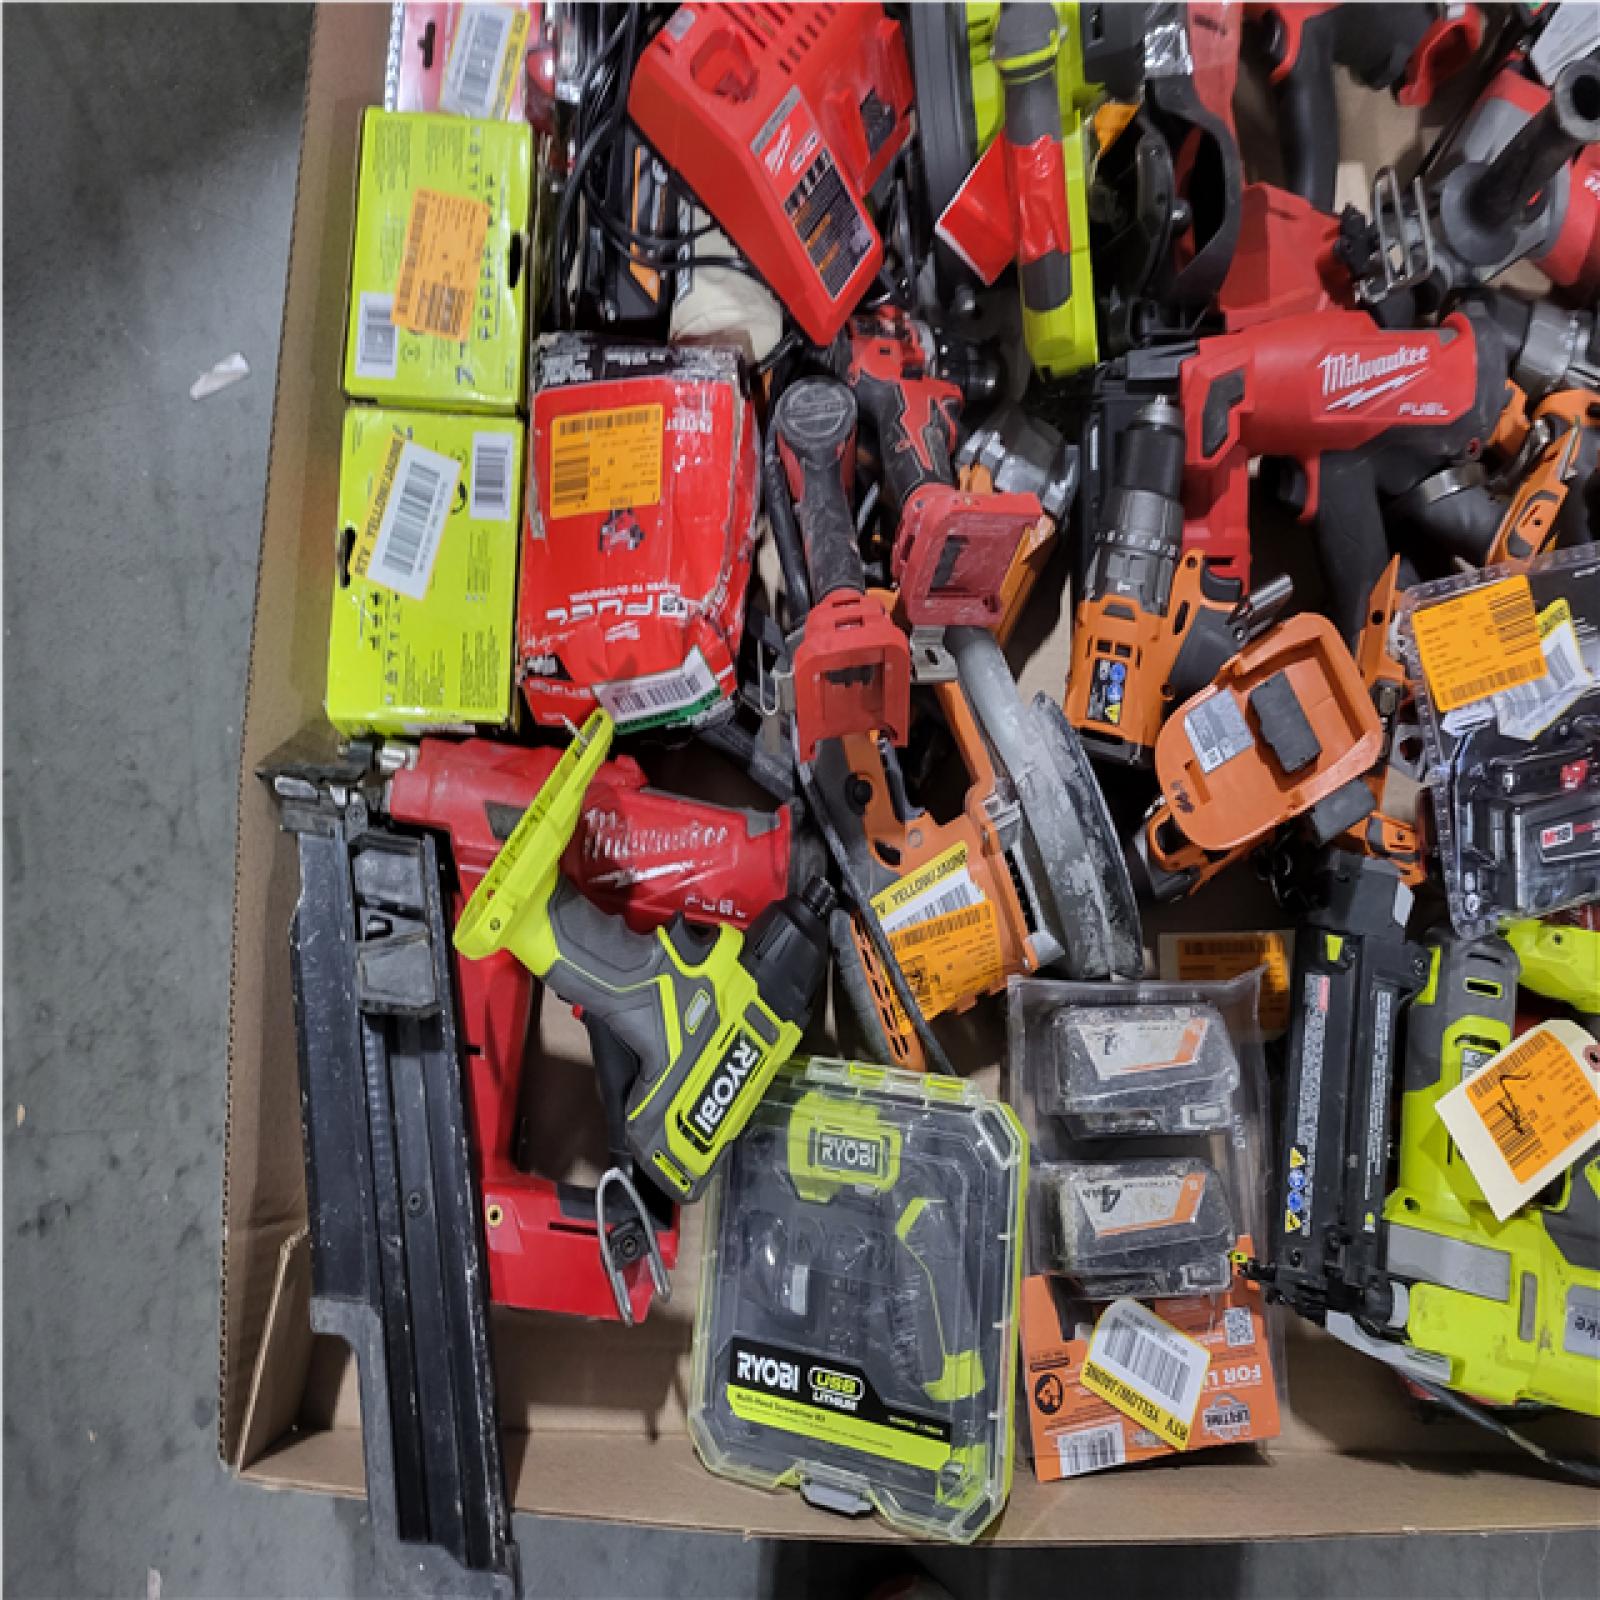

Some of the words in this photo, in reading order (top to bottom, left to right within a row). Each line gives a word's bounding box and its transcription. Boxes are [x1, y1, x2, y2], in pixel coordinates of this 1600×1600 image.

[1317, 345, 1429, 396] Milwaukee
[1398, 402, 1450, 416] FUEL
[546, 595, 653, 625] FUEL
[695, 1040, 760, 1133] RYOBI
[822, 1136, 876, 1168] RYOBI
[737, 1350, 800, 1393] RYOBI
[815, 1370, 857, 1394] USB
[1225, 1365, 1262, 1385] FOR
